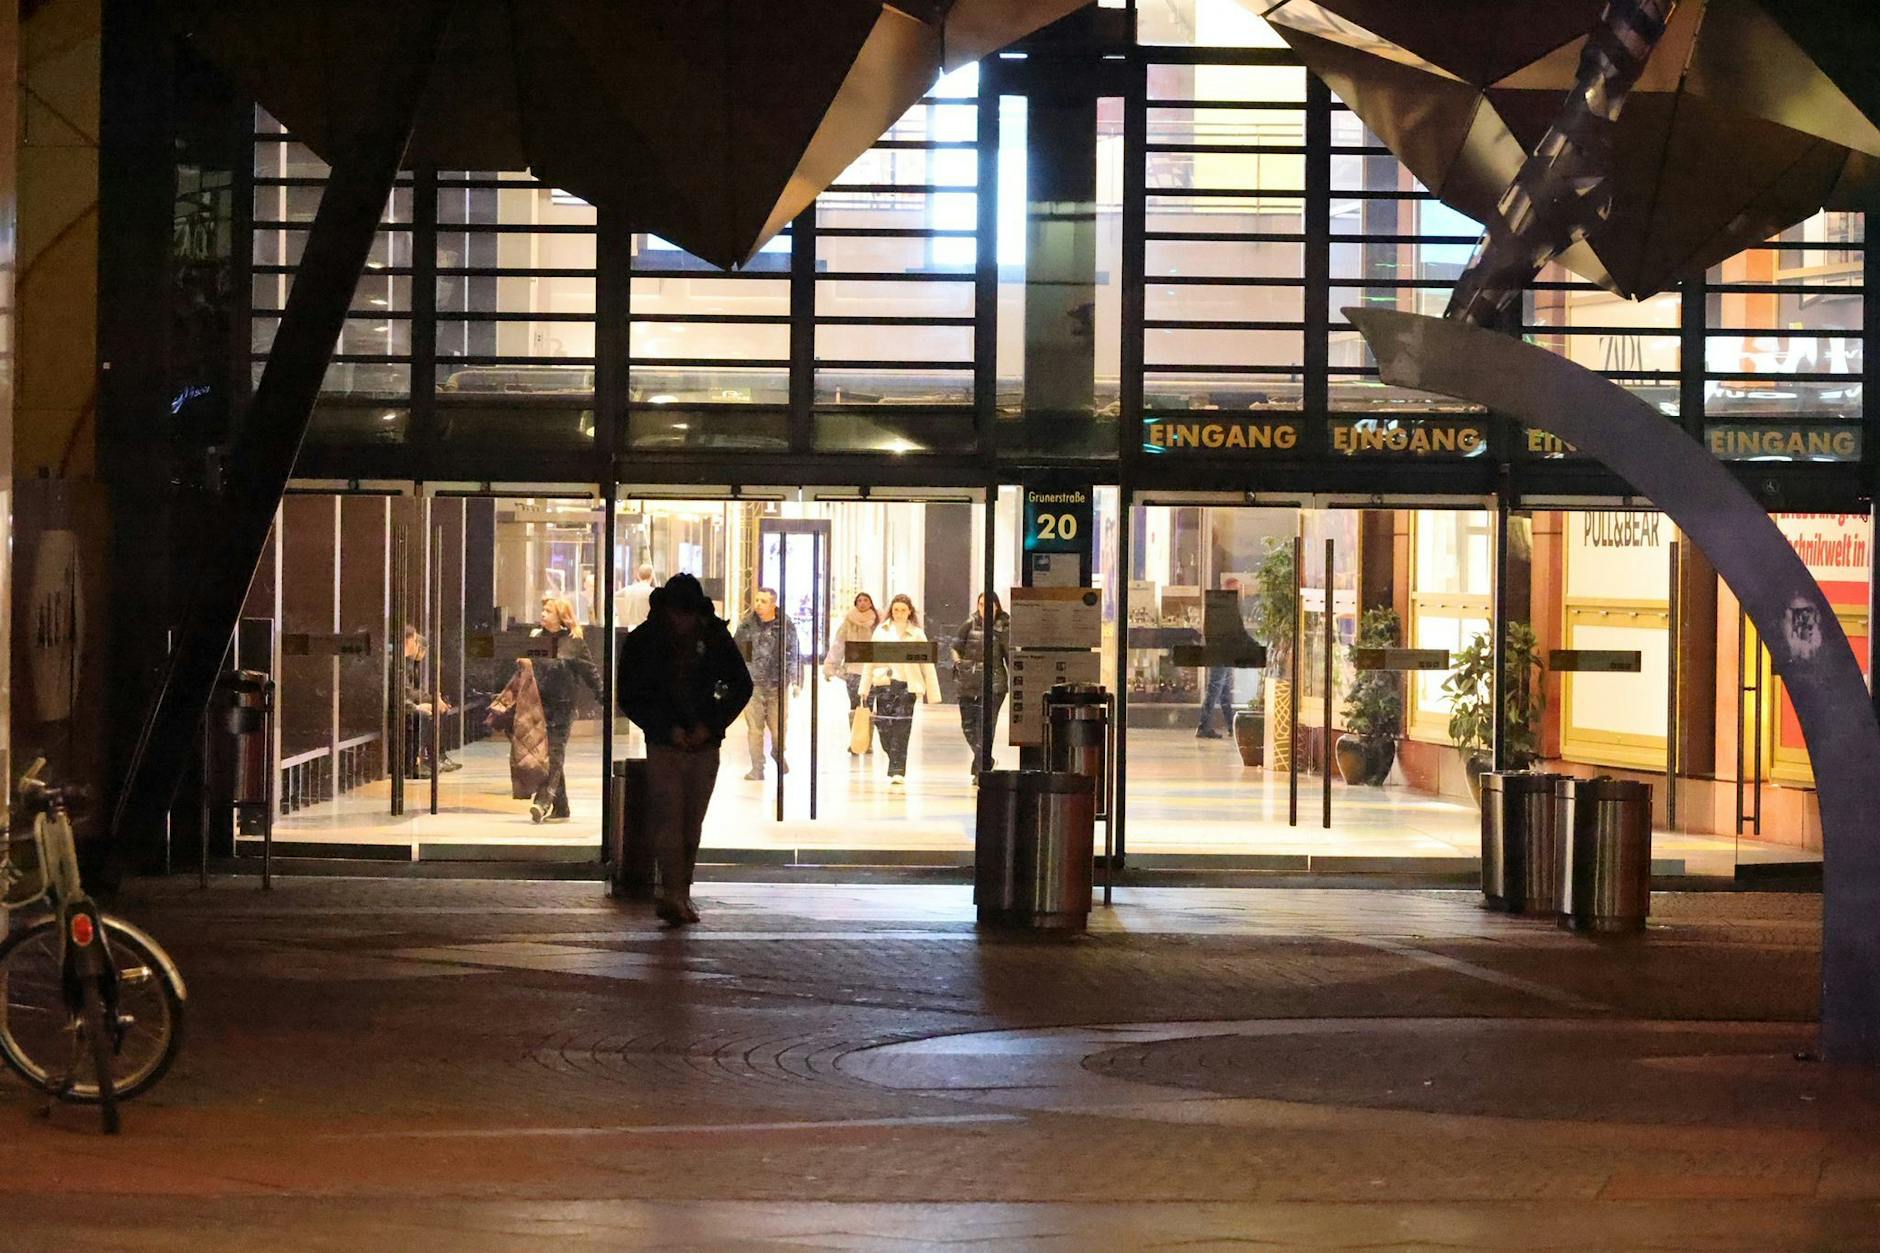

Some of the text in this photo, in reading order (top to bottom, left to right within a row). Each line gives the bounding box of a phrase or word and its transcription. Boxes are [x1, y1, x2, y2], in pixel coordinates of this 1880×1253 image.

[1150, 424, 1297, 449] EINGANG
[1334, 427, 1481, 452] EINGANG
[1711, 431, 1856, 455] EINGANG
[1028, 491, 1086, 503] Grunerstraße
[1037, 513, 1078, 540] 20
[1584, 511, 1660, 548] PULL&BEAR
[1853, 533, 1866, 567] in
